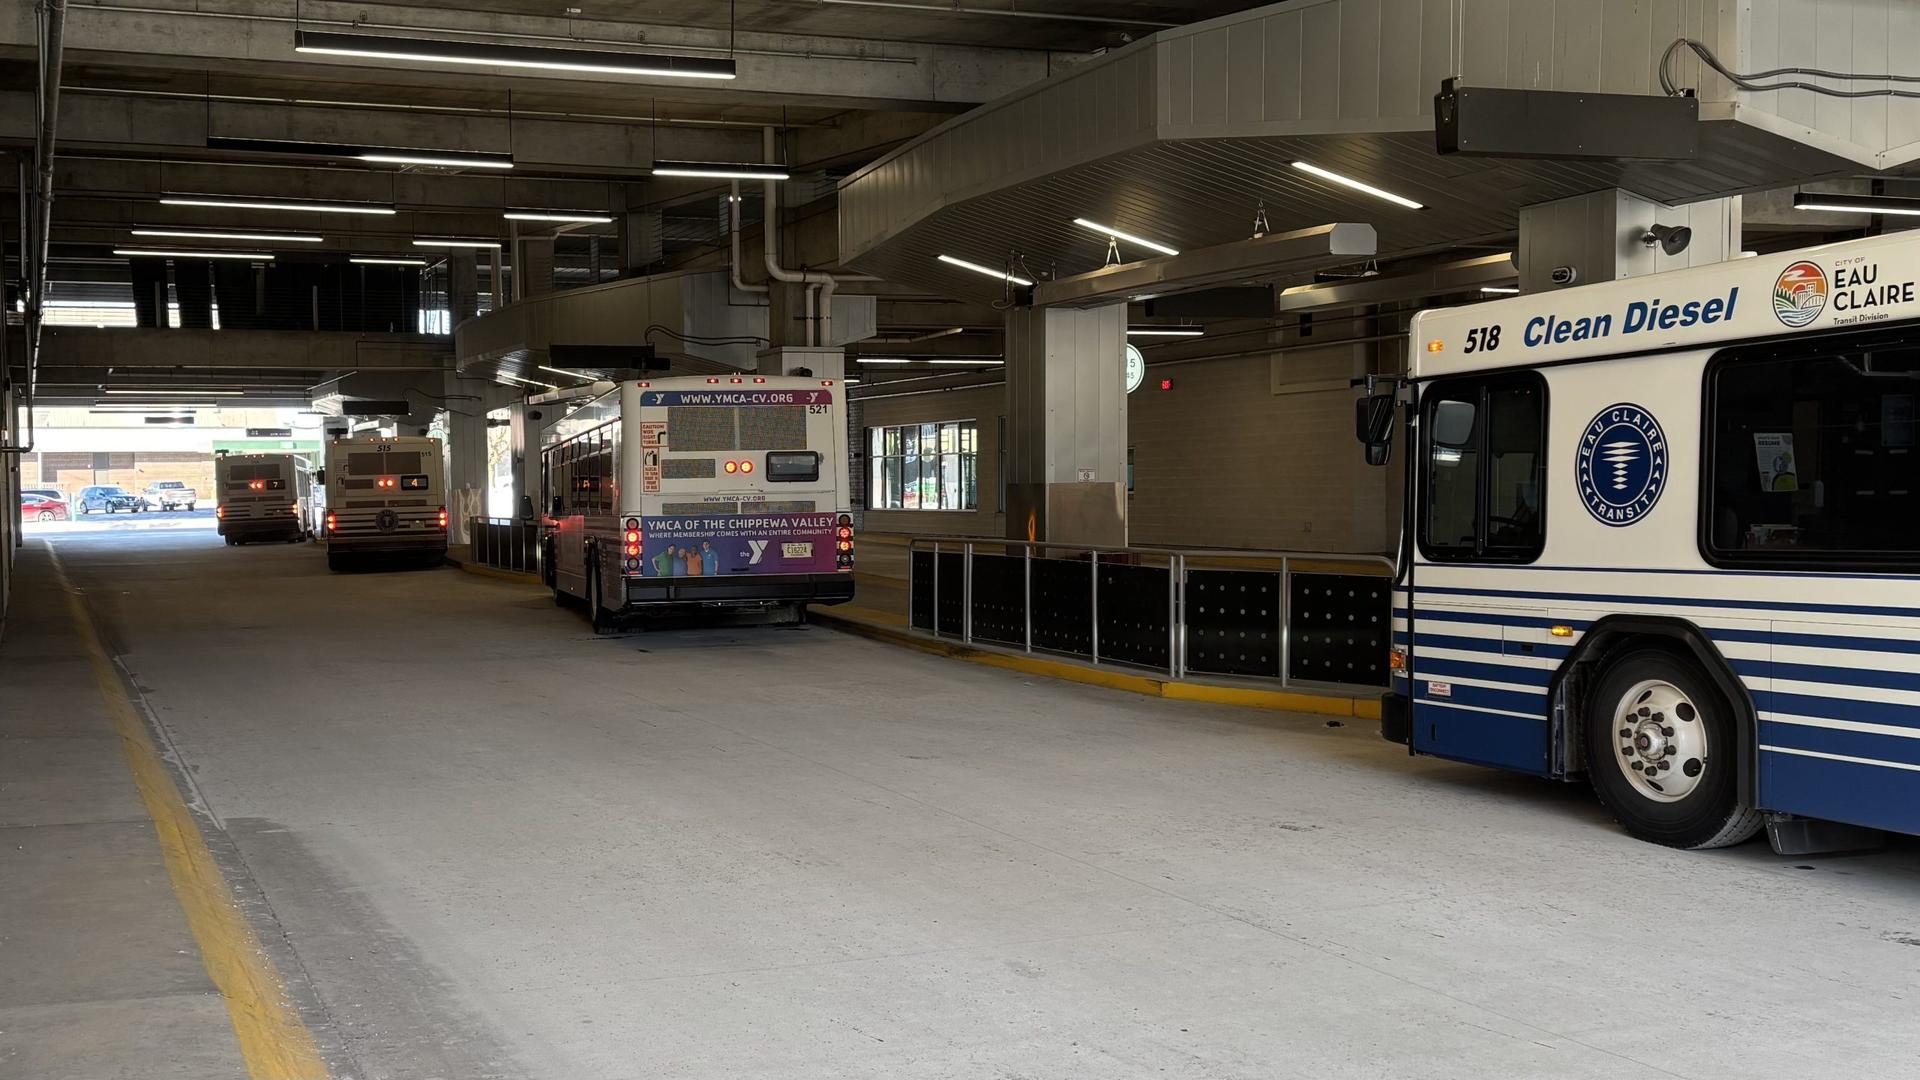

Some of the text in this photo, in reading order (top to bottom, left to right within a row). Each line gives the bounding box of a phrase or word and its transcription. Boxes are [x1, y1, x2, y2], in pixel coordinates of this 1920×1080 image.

[1835, 258, 1852, 267] CITY
[1834, 264, 1877, 289] EAU
[1834, 282, 1915, 311] CLAIRE
[1463, 287, 1740, 354] 518 Clean Diesel
[1833, 312, 1889, 325] Transit Division
[680, 394, 793, 404] WWW.YMCA-CV.ORG
[809, 405, 828, 414] 521
[1581, 409, 1663, 456] EAU CLAIRE
[411, 478, 418, 487] 4
[1590, 494, 1650, 520] TRANSIT
[648, 517, 834, 530] YMCA OF THE CHIPPEWA VALLEY
[792, 528, 833, 536] COMMUNITY
